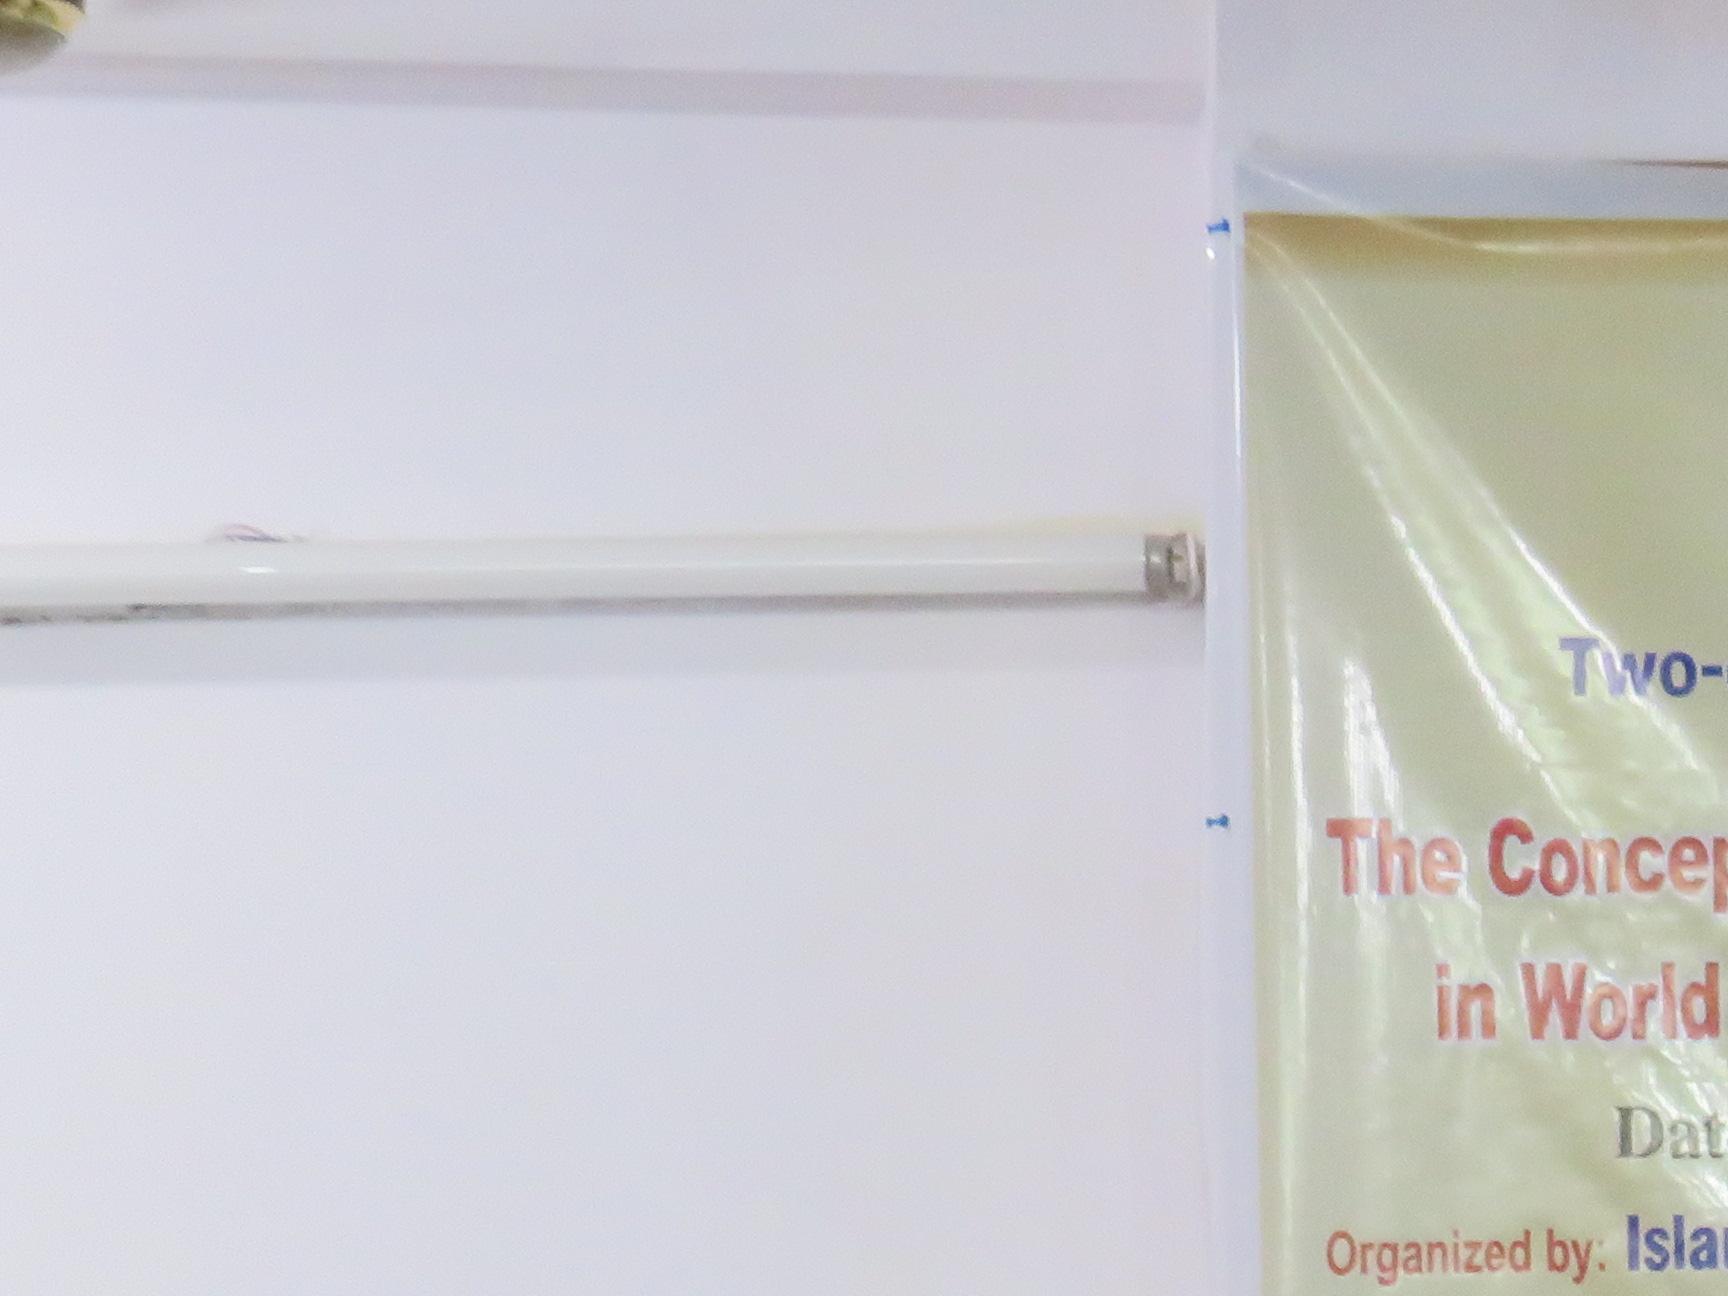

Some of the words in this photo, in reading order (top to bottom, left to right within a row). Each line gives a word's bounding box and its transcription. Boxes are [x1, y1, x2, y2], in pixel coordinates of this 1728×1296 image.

[1326, 817, 1466, 896] The
[1435, 962, 1498, 1041] in
[1519, 960, 1722, 1041] World
[1326, 1228, 1532, 1287] Organized
[1545, 1227, 1605, 1284] by:
